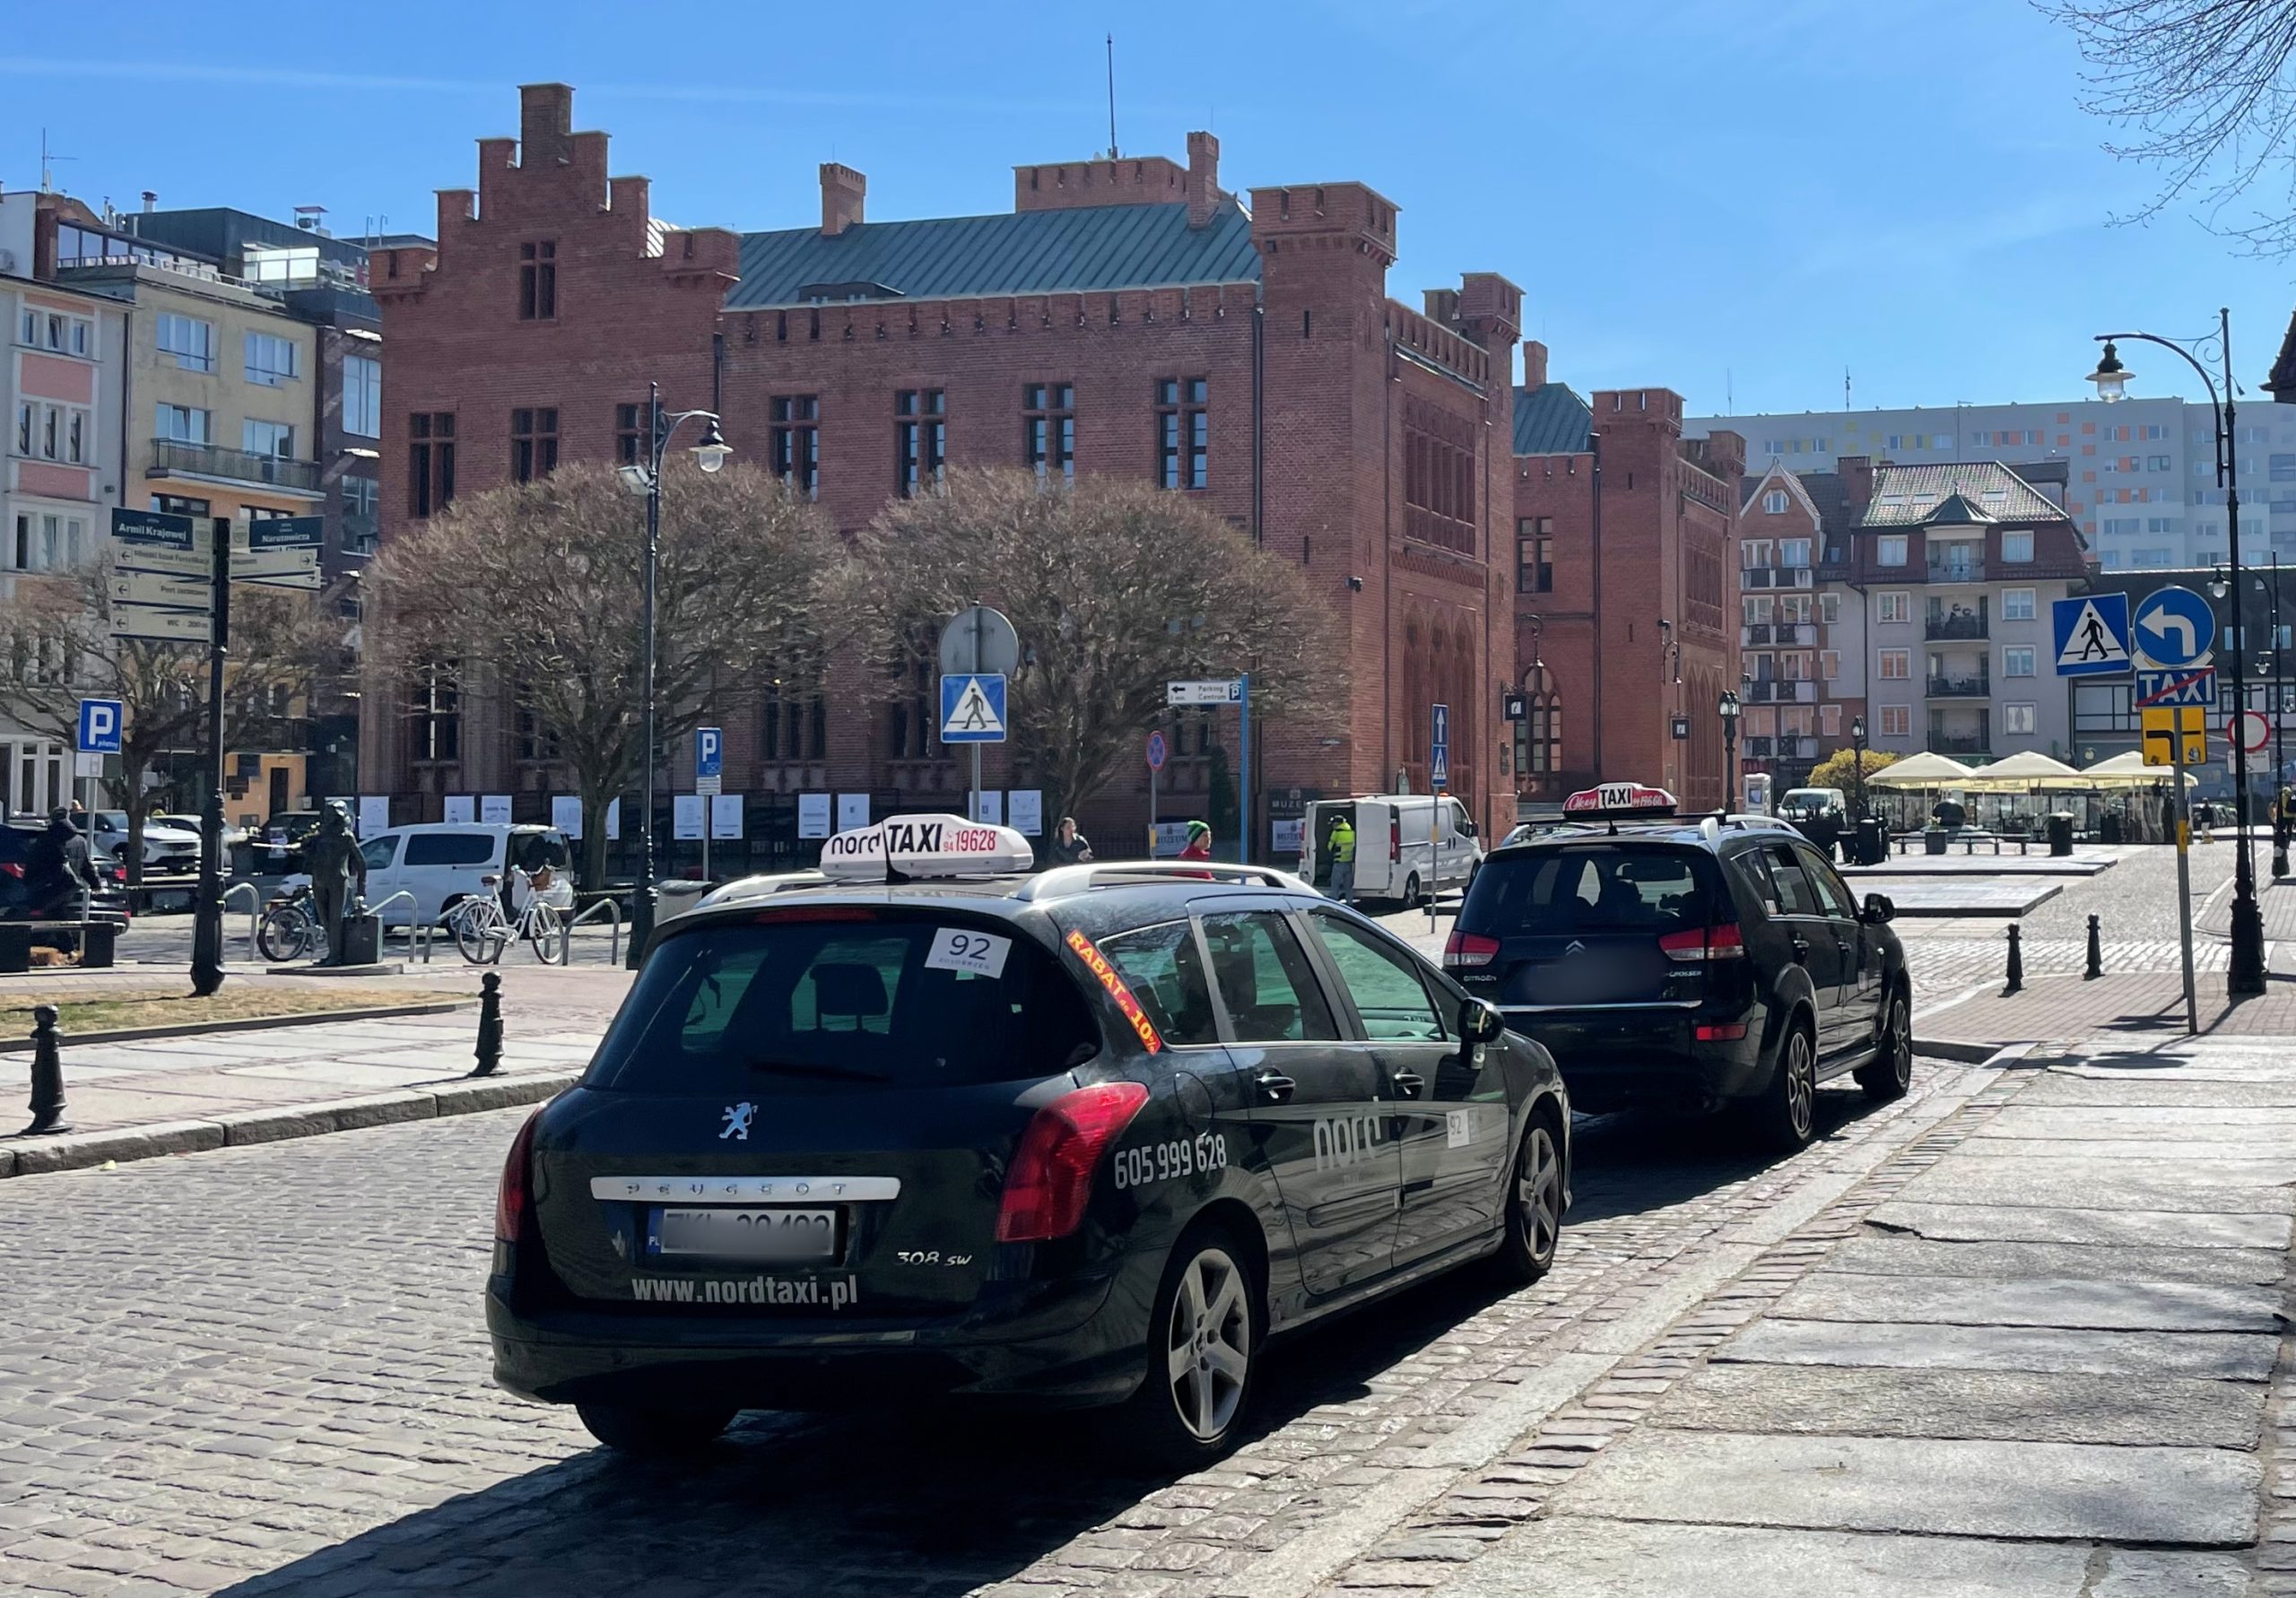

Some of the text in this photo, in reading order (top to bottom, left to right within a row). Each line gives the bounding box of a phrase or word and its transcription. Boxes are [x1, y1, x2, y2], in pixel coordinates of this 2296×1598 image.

[145, 525, 187, 542] Krajowej
[262, 533, 310, 543] Narutowicza
[1198, 685, 1223, 693] Parking
[2139, 673, 2213, 702] TAXI
[88, 706, 114, 745] P
[702, 733, 717, 762] P
[1599, 788, 1631, 805] TAXI
[831, 823, 997, 855] nord TAXI 94 19628
[949, 934, 990, 960] 92
[1068, 932, 1126, 995] RABAT
[1130, 1010, 1156, 1052] 10%
[1449, 1115, 1462, 1136] 92
[1114, 1133, 1227, 1189] 605 999 628
[626, 1183, 847, 1195] PEUGEOT
[648, 1236, 660, 1246] PL
[896, 1251, 940, 1265] 308
[631, 1274, 857, 1311] www.nordtaxi.pl
